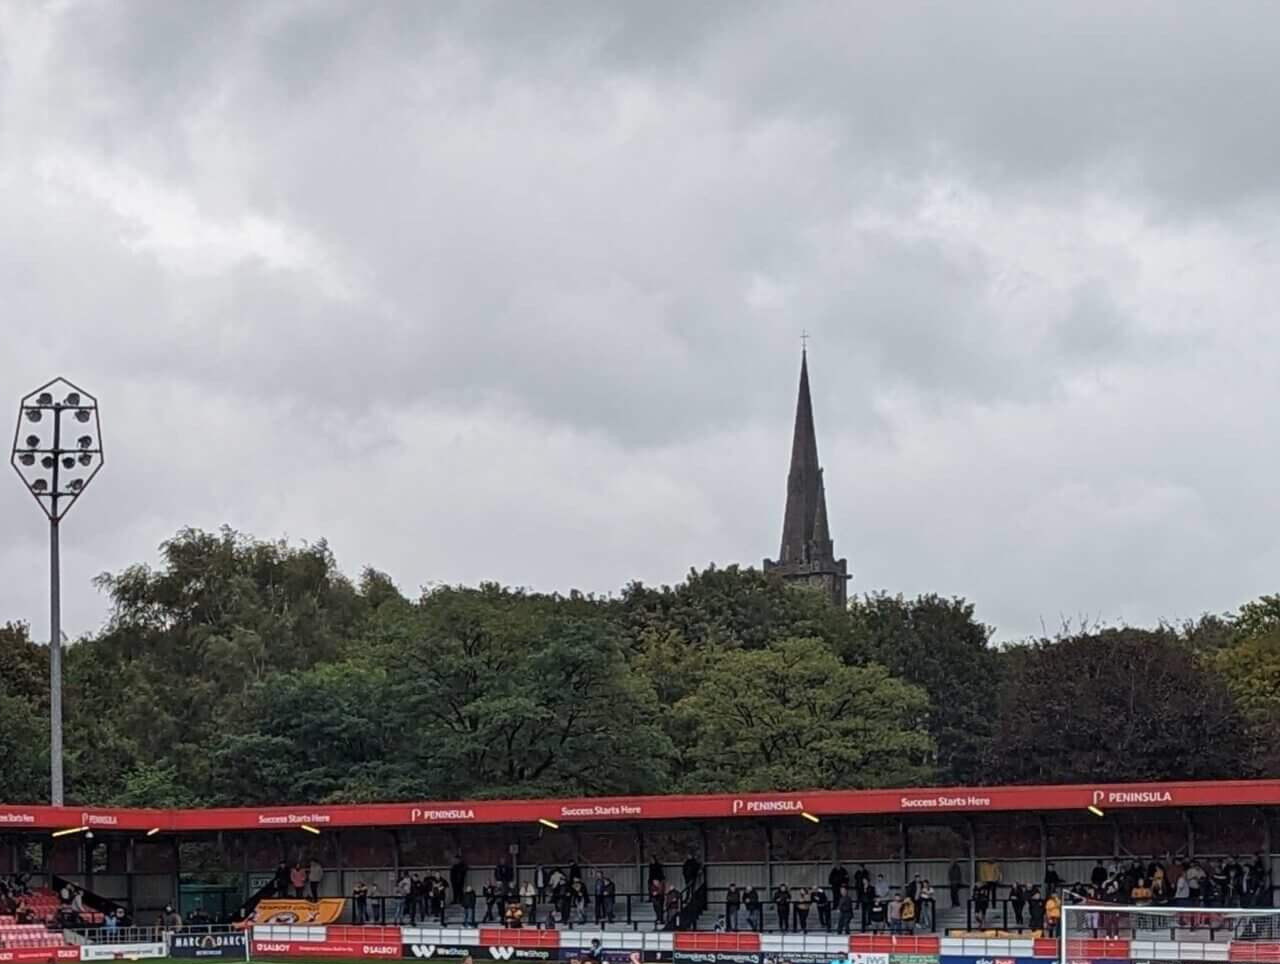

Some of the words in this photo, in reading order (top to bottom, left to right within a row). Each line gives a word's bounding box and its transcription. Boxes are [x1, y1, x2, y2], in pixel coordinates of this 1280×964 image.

[901, 797, 937, 808] Success
[938, 796, 966, 807] Starts
[967, 795, 990, 806] Here
[1108, 791, 1172, 803] PENINSULA
[561, 806, 593, 817] Success
[594, 805, 620, 816] Starts
[621, 804, 641, 815] Here
[747, 800, 803, 812] PENINSULA
[258, 814, 287, 824] Success
[288, 814, 311, 824] Starts
[311, 813, 330, 823] Here
[424, 809, 474, 820] PENINSULA
[175, 937, 200, 947] MARC
[216, 936, 246, 946] DARCY
[263, 944, 290, 952] SALBOY
[369, 946, 398, 954] SALBOY
[437, 947, 469, 956] WeShop
[516, 949, 549, 959] WeShop
